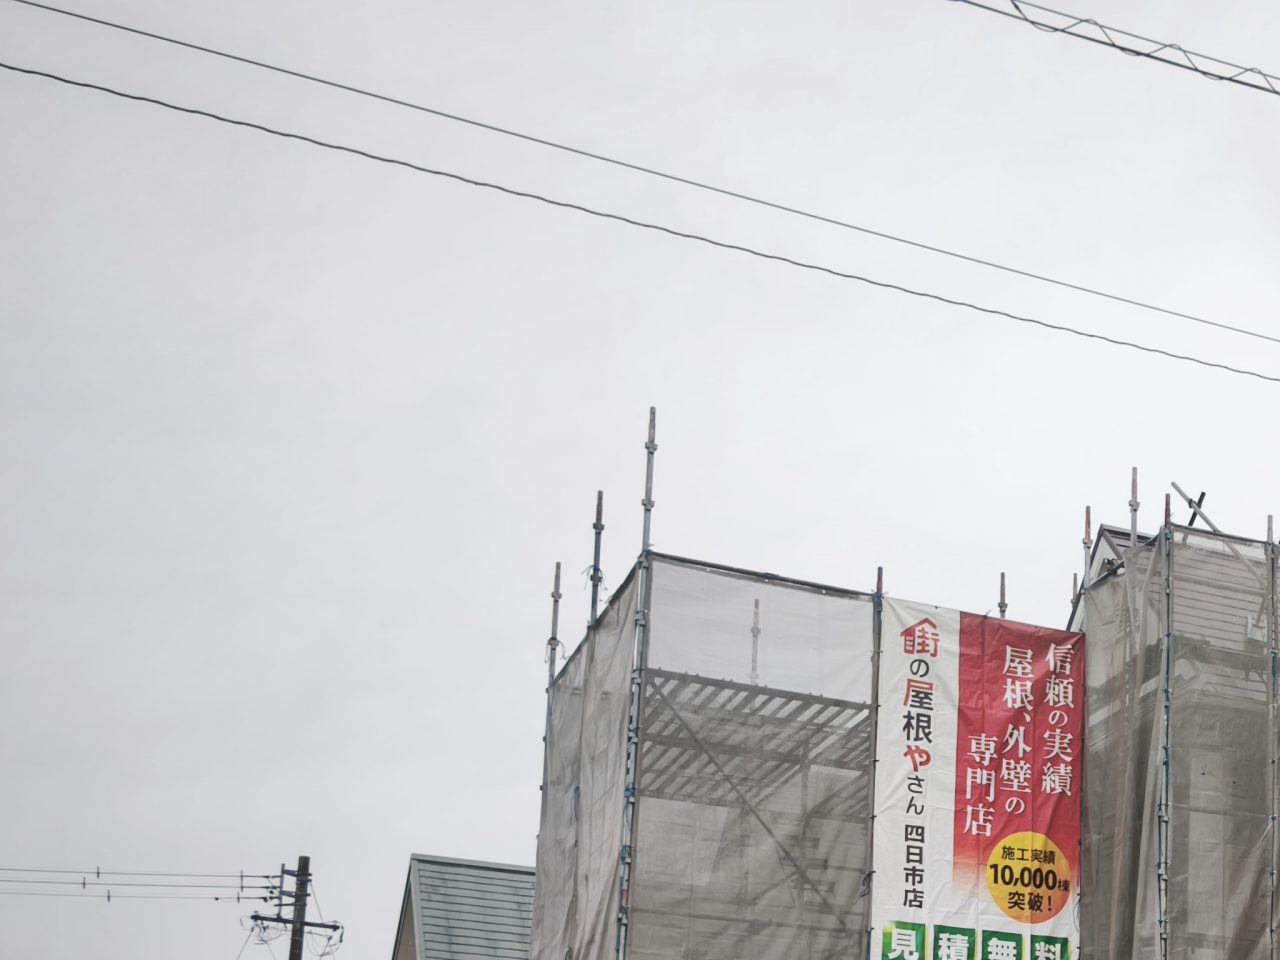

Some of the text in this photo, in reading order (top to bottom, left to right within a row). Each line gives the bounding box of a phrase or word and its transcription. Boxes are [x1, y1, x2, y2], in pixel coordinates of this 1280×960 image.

[1000, 645, 1035, 815] 屋根、外壁の
[1041, 643, 1075, 797] 信頼の実績
[963, 733, 998, 837] 専門店
[903, 823, 925, 909] 四日市店
[989, 864, 1070, 893] 10,000棟
[1001, 846, 1056, 865] 施工実績
[1008, 892, 1053, 913] 突破！
